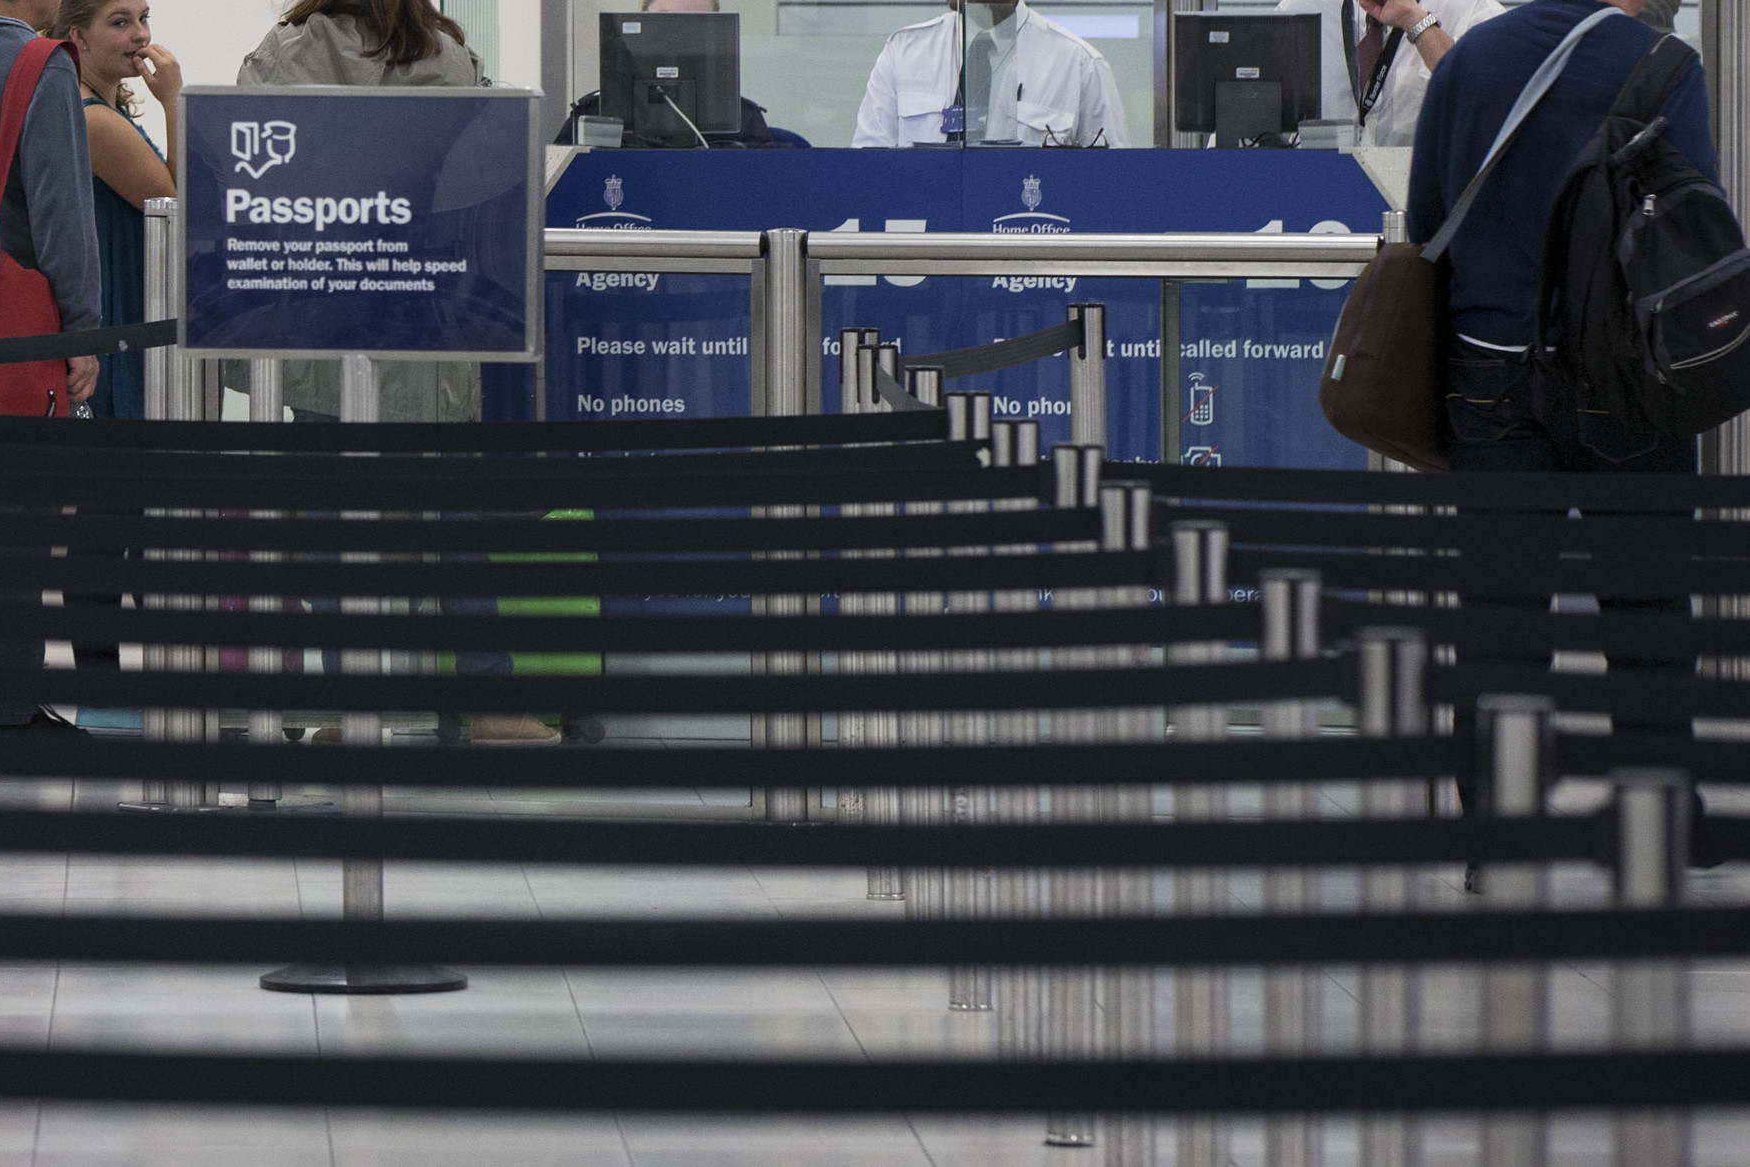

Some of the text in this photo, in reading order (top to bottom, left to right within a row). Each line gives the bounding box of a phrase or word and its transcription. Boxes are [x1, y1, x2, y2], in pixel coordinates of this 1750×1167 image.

[226, 189, 412, 231] Passports
[227, 238, 408, 256] Remove your passport from
[227, 257, 466, 274] wallet or holder. This will help speed
[227, 277, 435, 294] examination of your documents
[576, 273, 659, 290] Agency
[578, 337, 747, 354] Please wait until
[1121, 340, 1160, 358] unti
[1243, 340, 1324, 358] forward
[579, 395, 685, 415] No phones
[993, 396, 1021, 415] No
